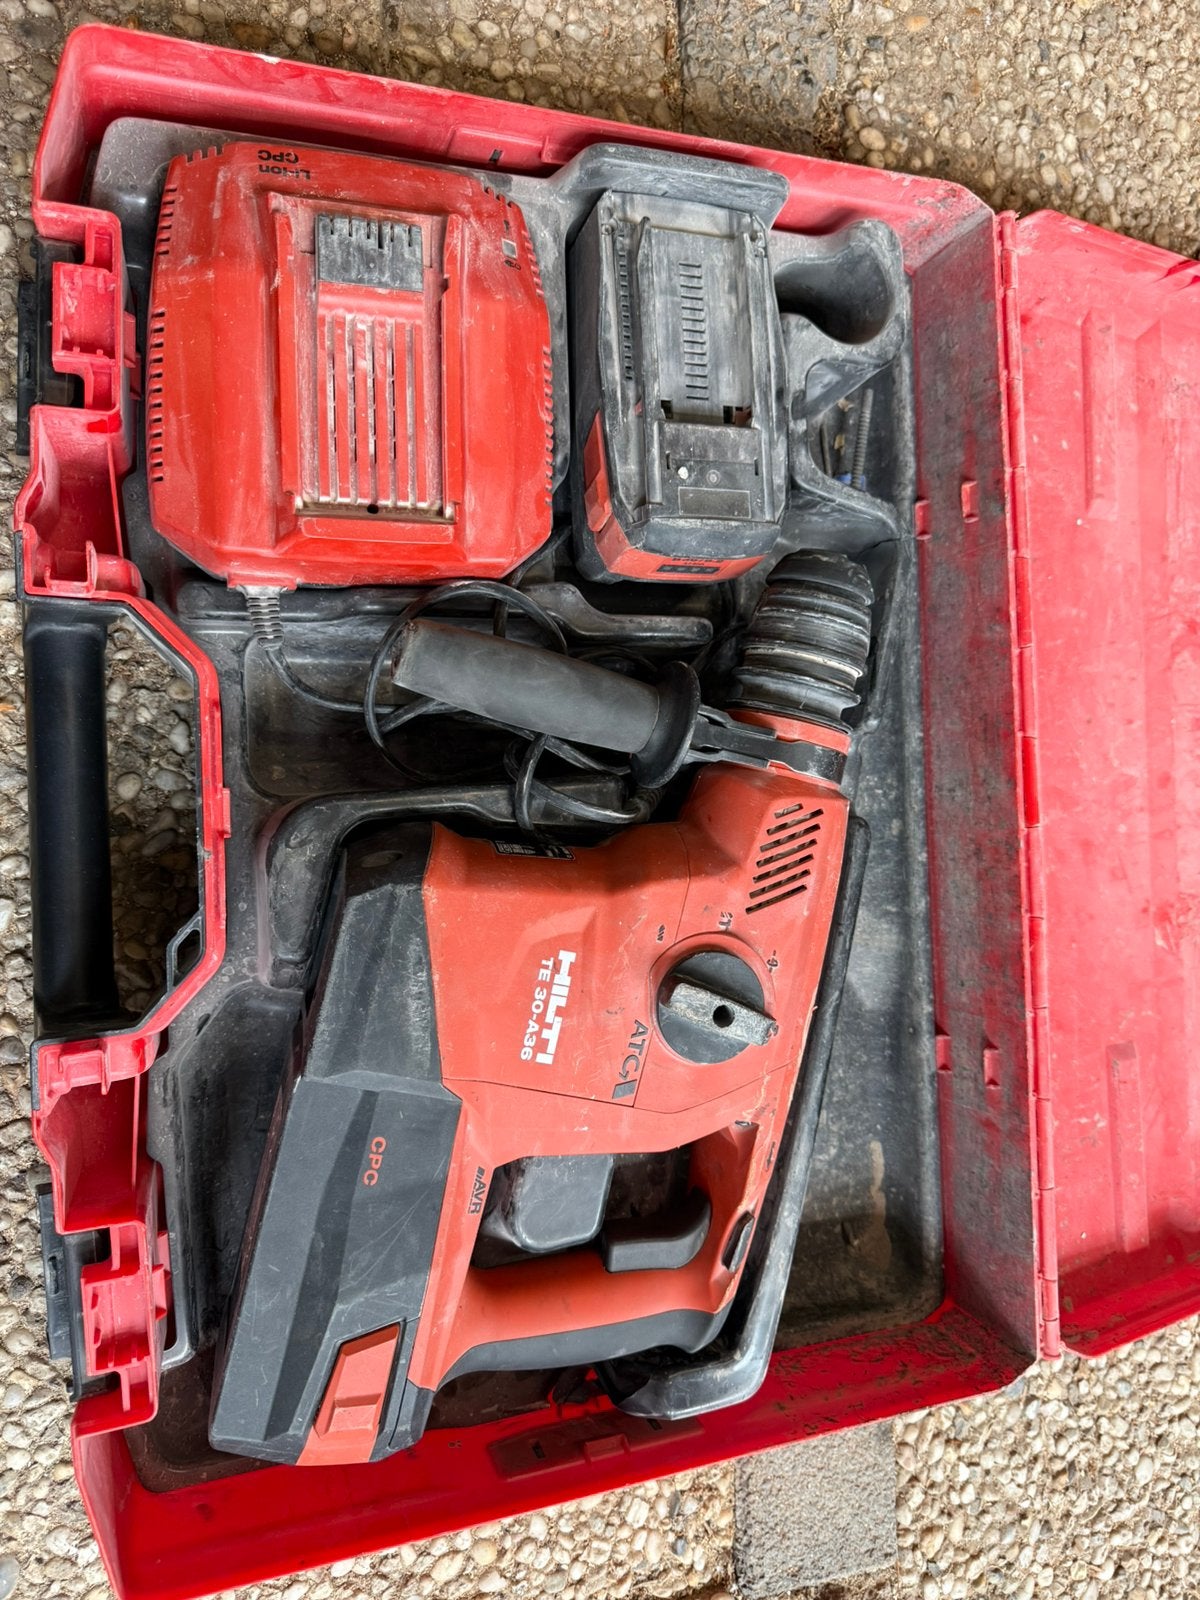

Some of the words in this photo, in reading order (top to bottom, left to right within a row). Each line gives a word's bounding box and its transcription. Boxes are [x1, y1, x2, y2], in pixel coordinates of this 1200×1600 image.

[258, 150, 299, 164] CPC
[537, 957, 554, 982] TE
[520, 986, 547, 1061] 30-A36
[535, 949, 577, 1065] HILTI
[363, 1136, 387, 1186] CPC
[470, 1180, 487, 1215] AVR
